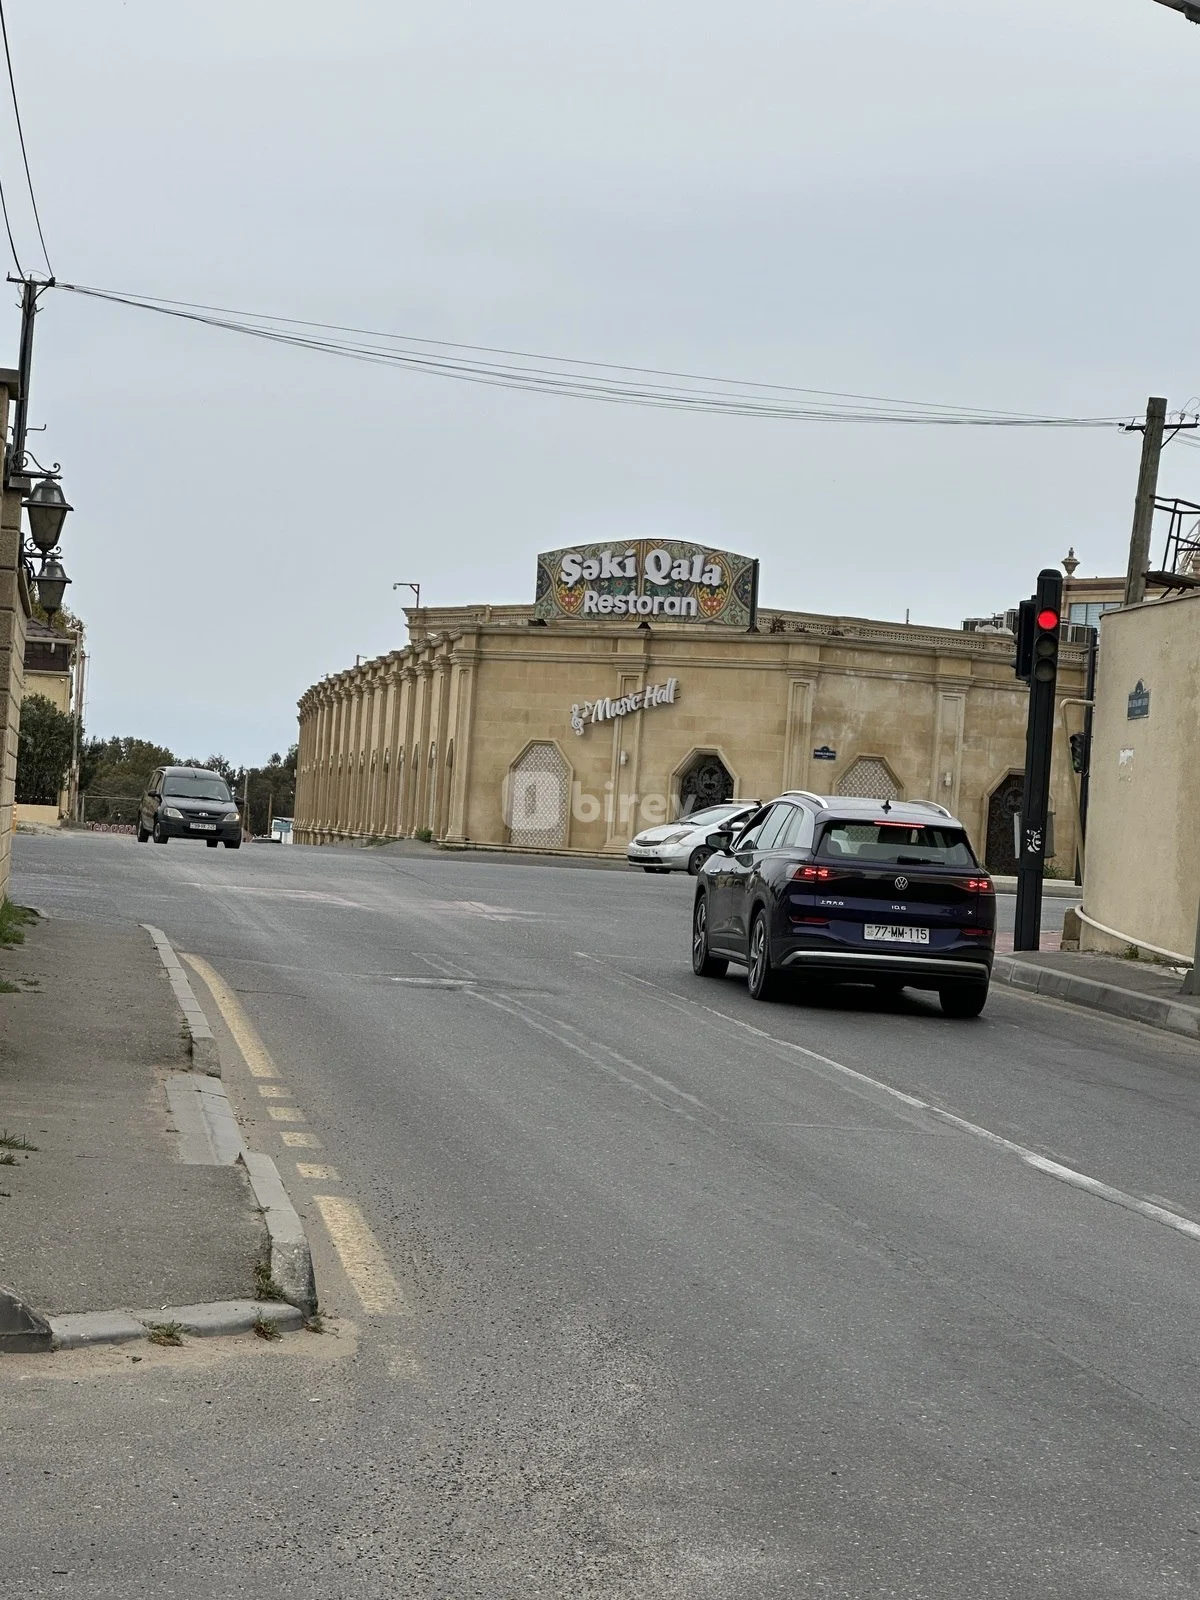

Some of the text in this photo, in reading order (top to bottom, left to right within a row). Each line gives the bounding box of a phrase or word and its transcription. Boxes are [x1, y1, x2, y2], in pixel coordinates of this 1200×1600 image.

[561, 550, 722, 587] Şəki Qala
[584, 590, 698, 616] Restoran
[591, 677, 677, 723] Music Hall
